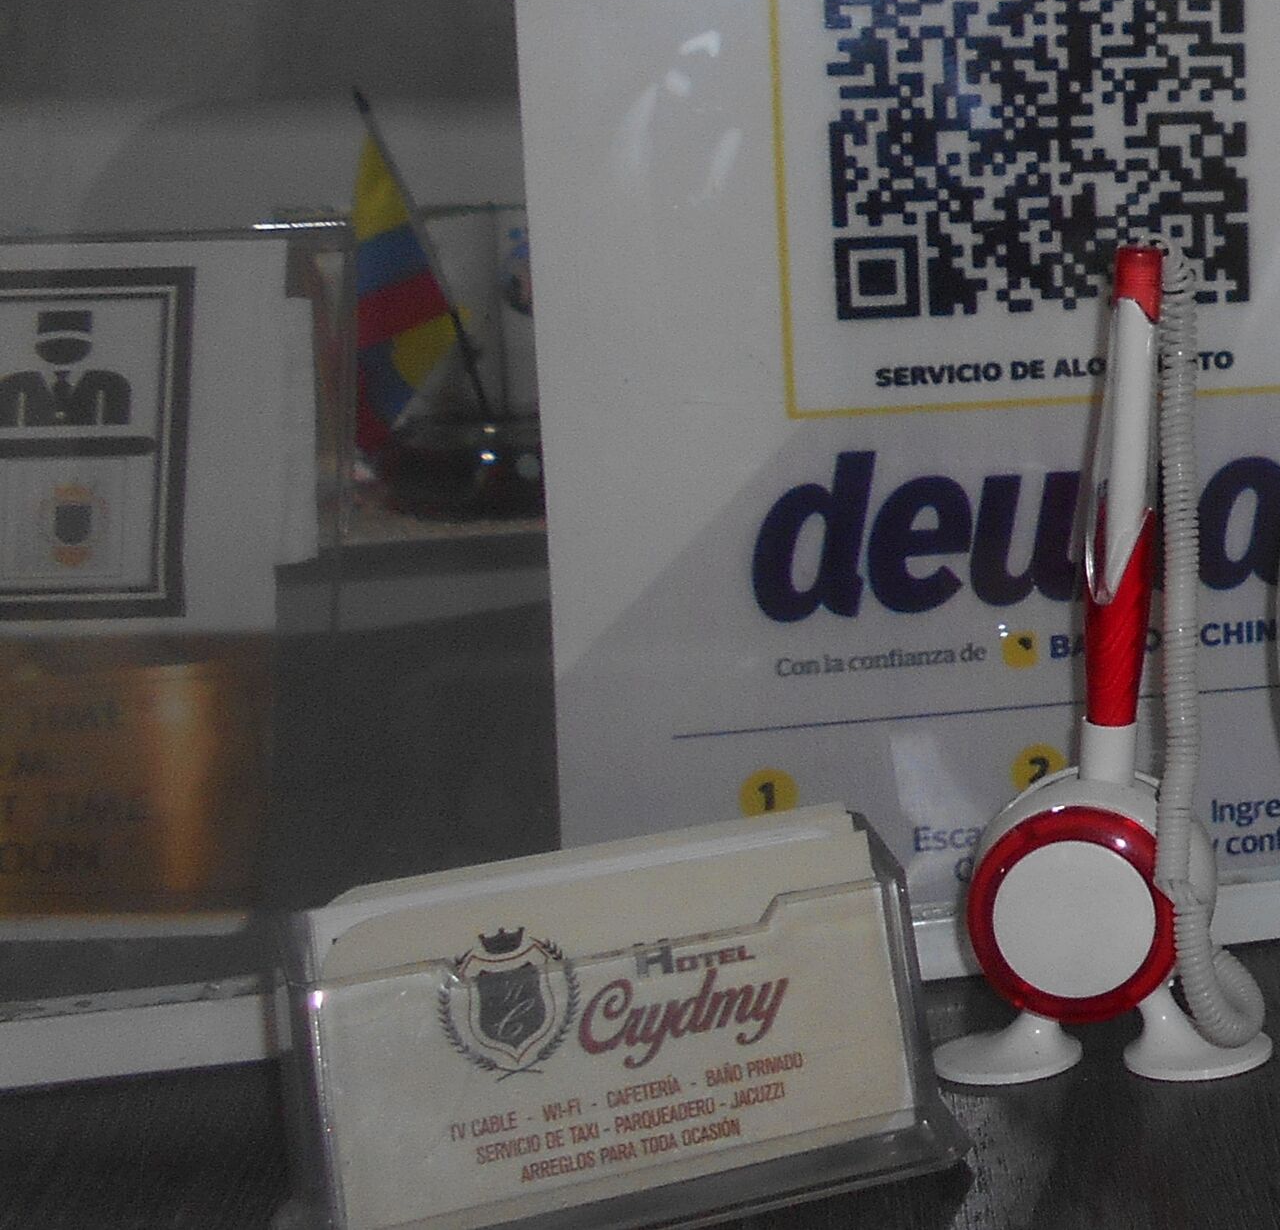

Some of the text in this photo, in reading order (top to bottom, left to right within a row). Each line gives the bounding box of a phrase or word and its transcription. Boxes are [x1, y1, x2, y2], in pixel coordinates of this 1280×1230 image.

[876, 362, 1002, 387] SERVICIO
[1010, 359, 1046, 381] DE
[775, 657, 821, 678] Con
[823, 654, 845, 674] la
[847, 648, 957, 671] confianza
[959, 643, 988, 663] de
[758, 781, 775, 811] 1
[450, 1051, 804, 1142] TV CABLE WI-FI CAFETERÍA BAÑO PRIVADO
[475, 1081, 786, 1165] SERVICIO DE TAXI PARQUEADERO JACUZZI
[520, 1116, 742, 1184] ARREGLOS PARA TODA OCASIÓN
